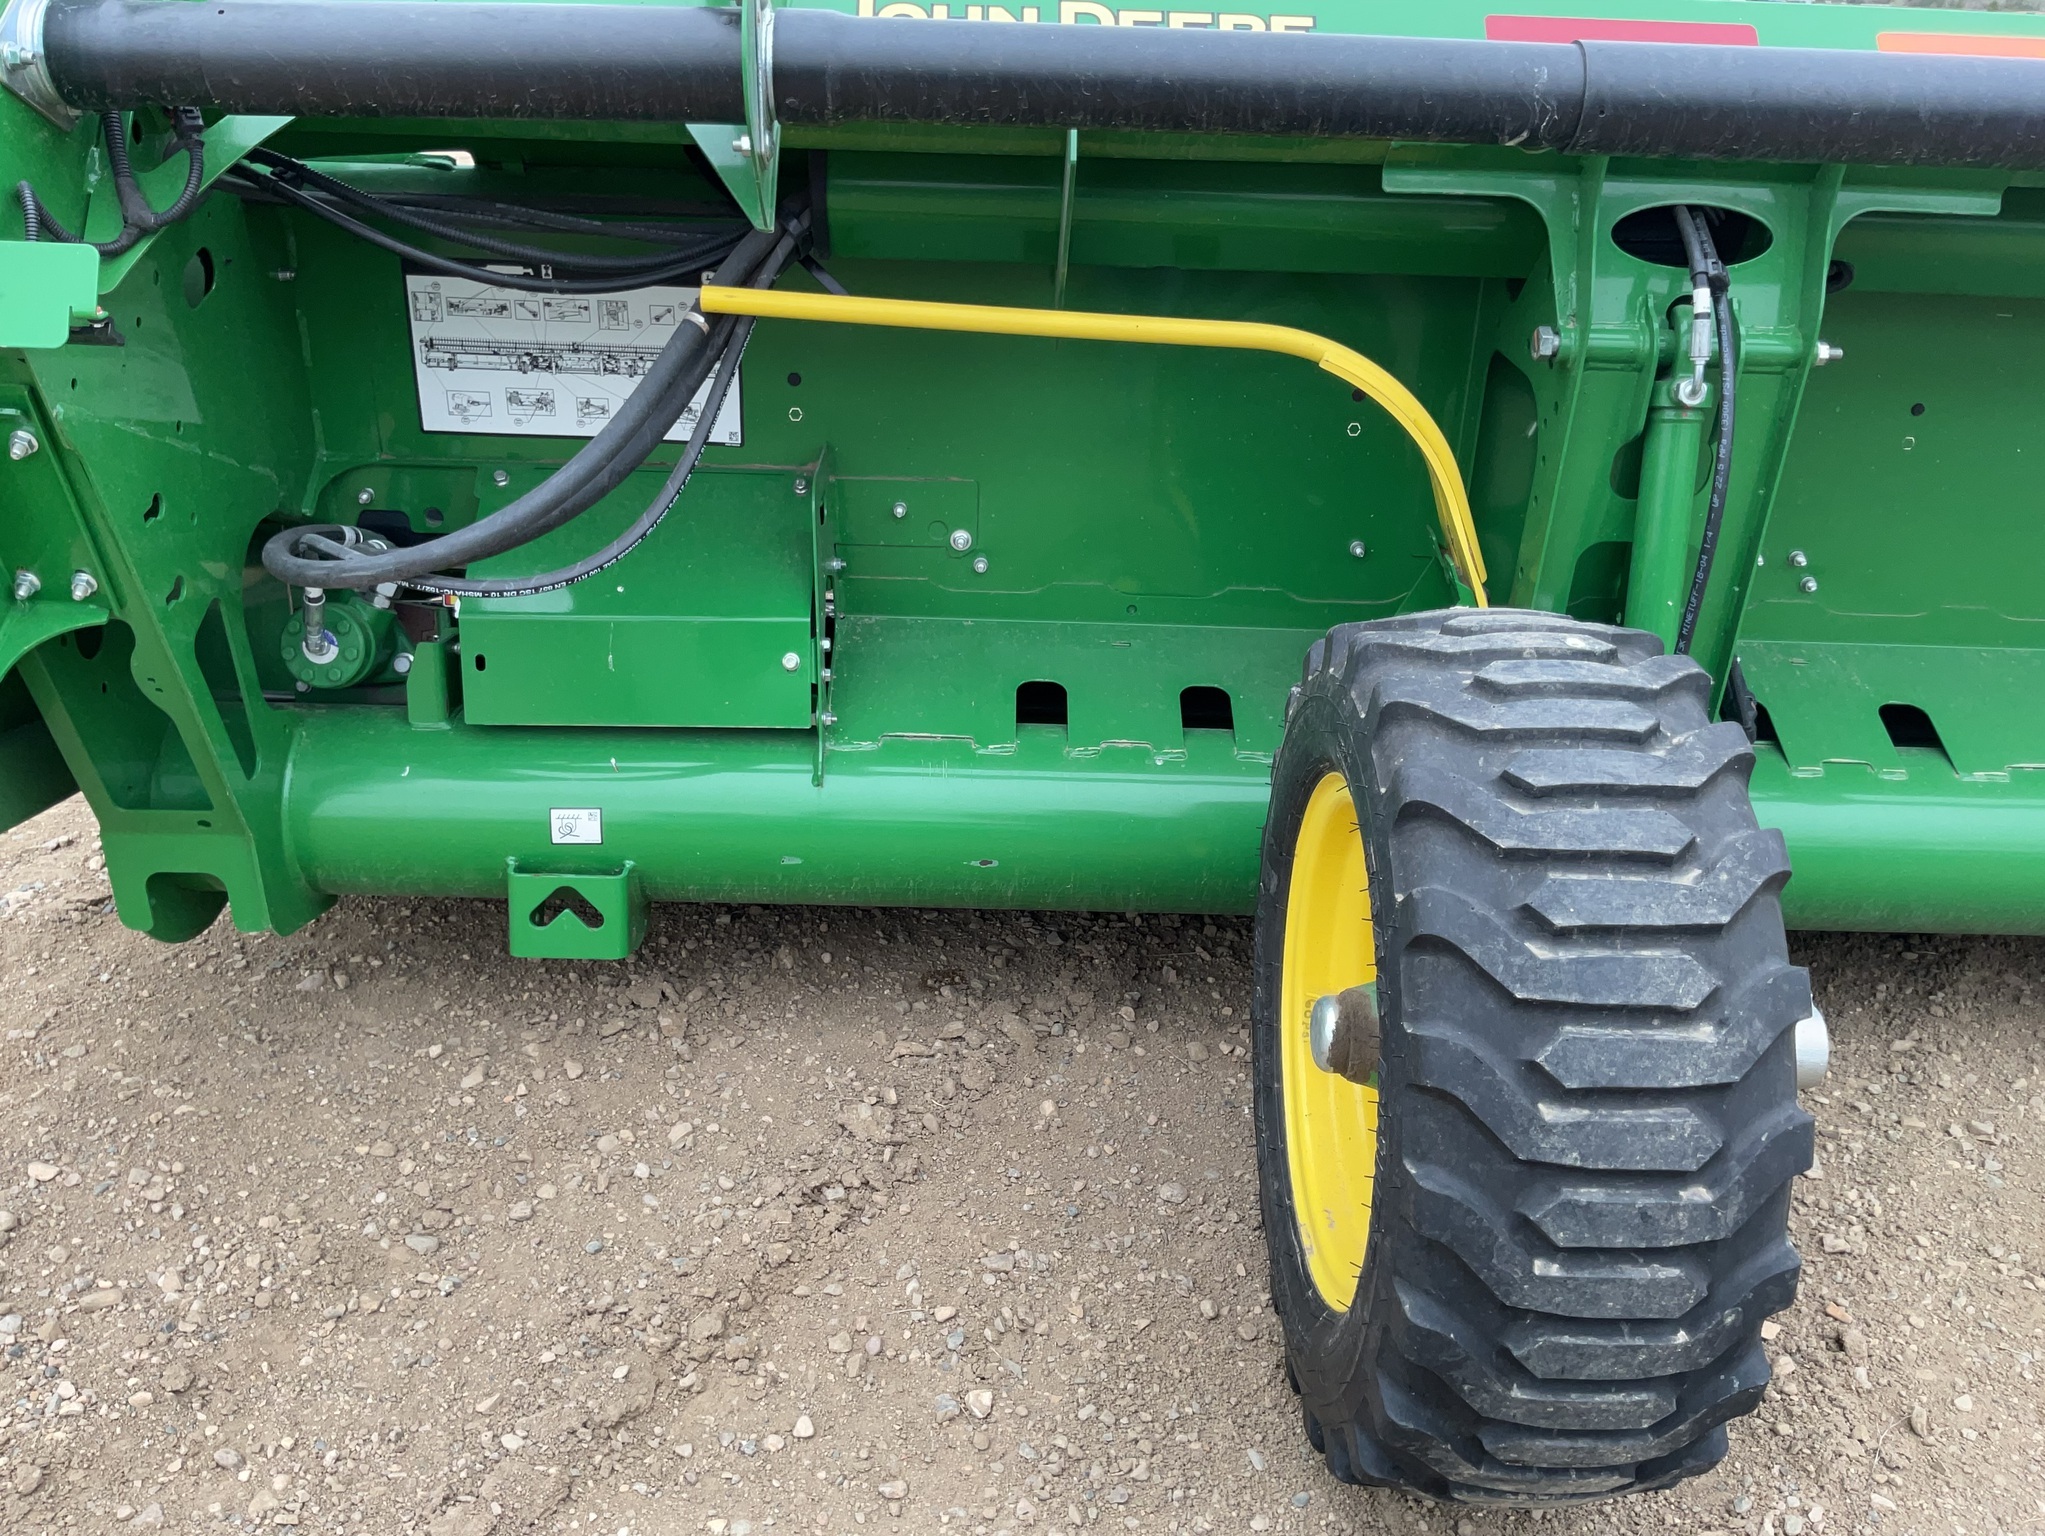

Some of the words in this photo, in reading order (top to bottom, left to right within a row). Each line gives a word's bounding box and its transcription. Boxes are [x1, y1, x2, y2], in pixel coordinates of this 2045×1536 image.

[1714, 464, 1724, 490] 22.5
[1719, 439, 1727, 458] MPa
[589, 567, 602, 577] 100
[554, 581, 567, 590] EN
[455, 590, 483, 598] MSHA
